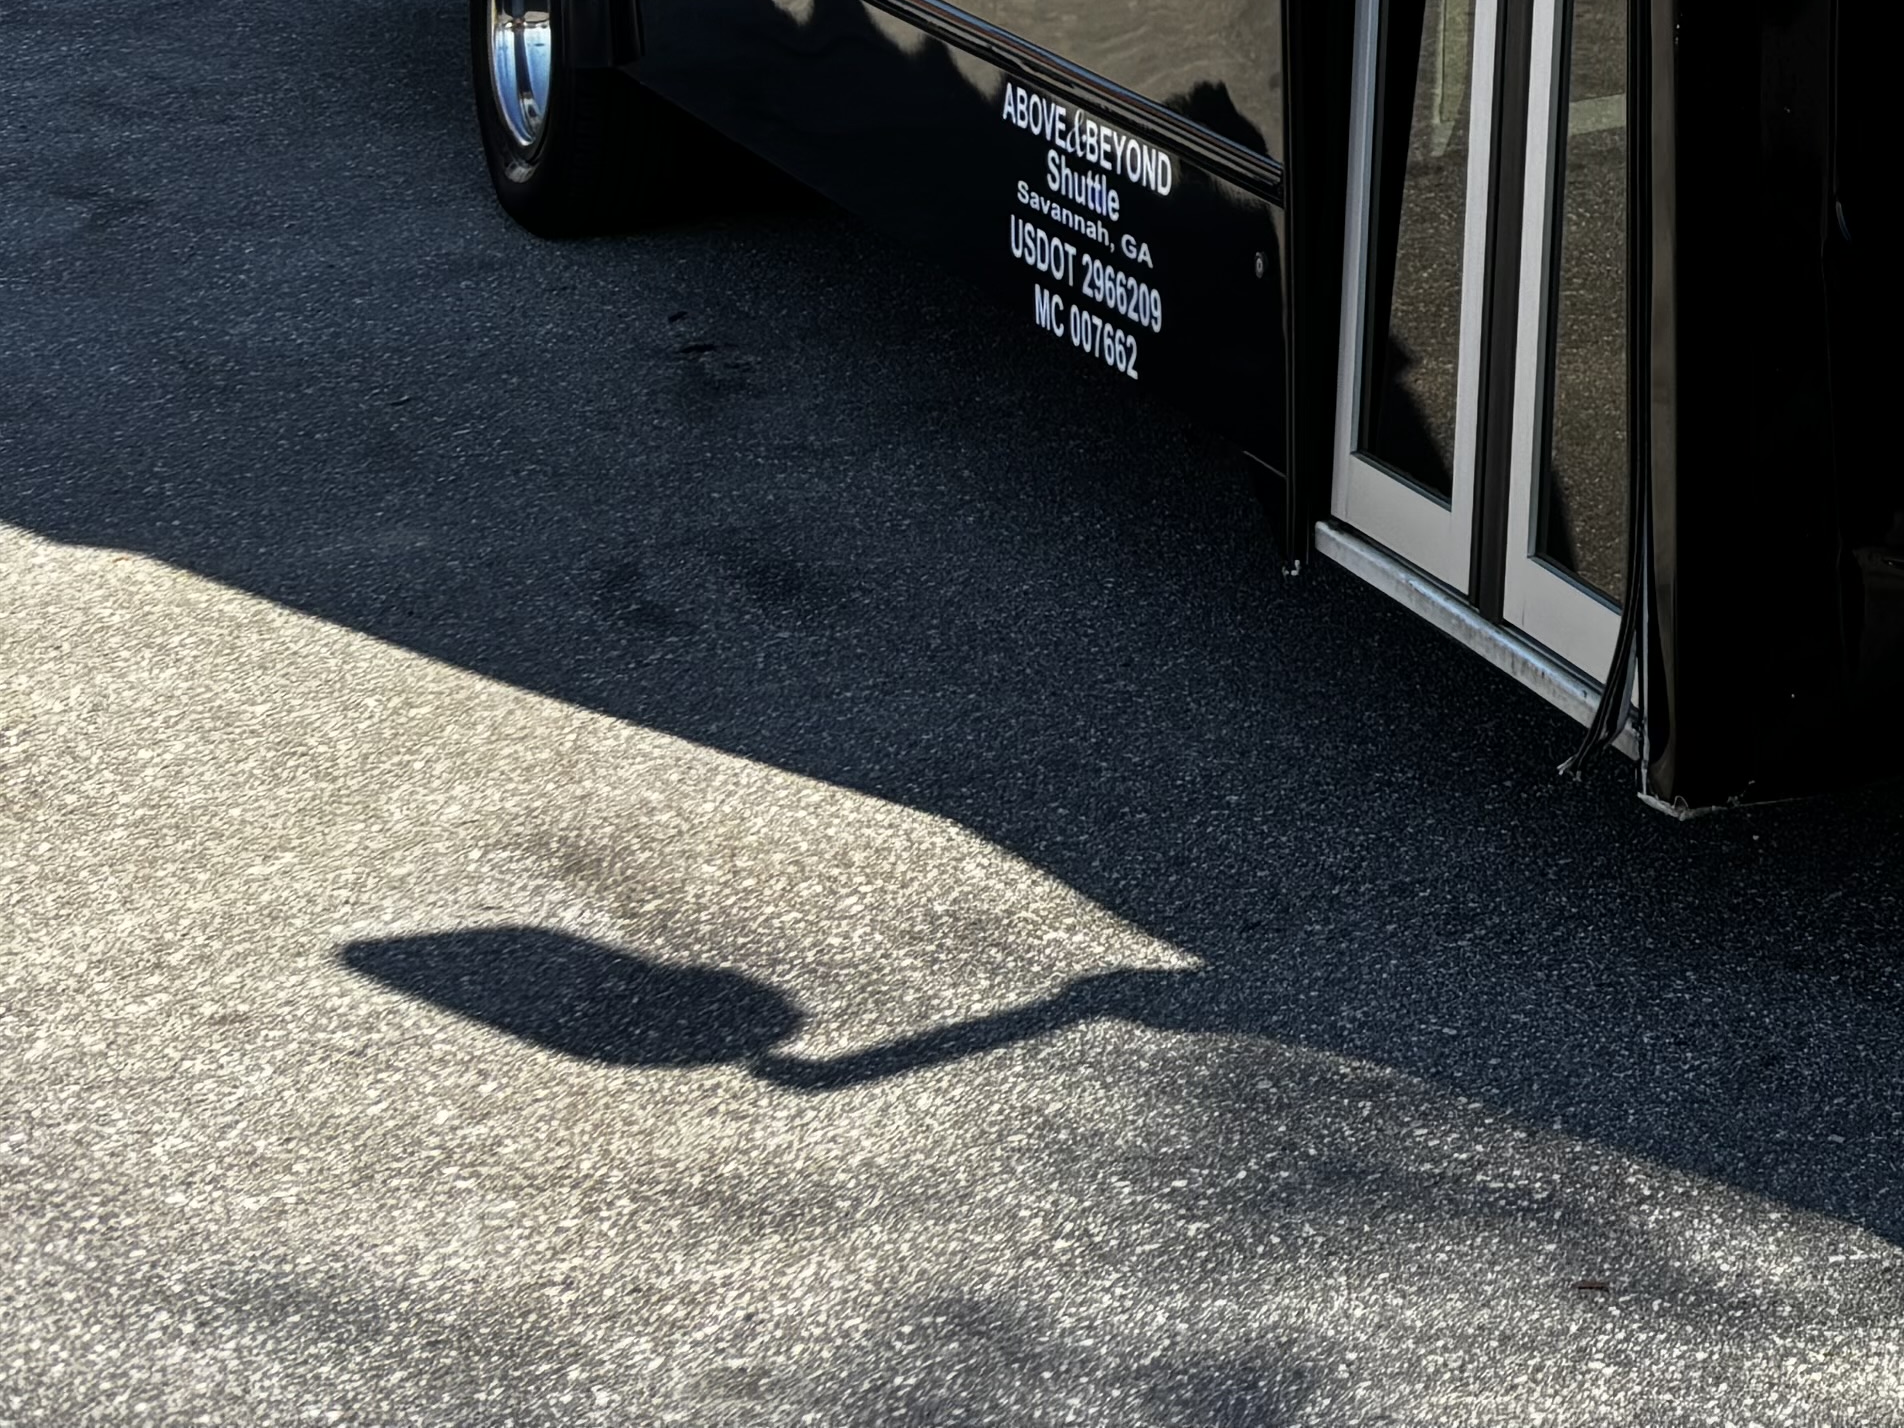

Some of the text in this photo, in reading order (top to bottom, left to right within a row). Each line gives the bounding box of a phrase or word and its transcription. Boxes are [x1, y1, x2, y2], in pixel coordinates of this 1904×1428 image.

[1017, 180, 1153, 268] Savannah, GA
[1047, 149, 1120, 221] Shuttle
[1010, 215, 1162, 333] USDOT 2966209
[1035, 284, 1138, 380] MC 007662
